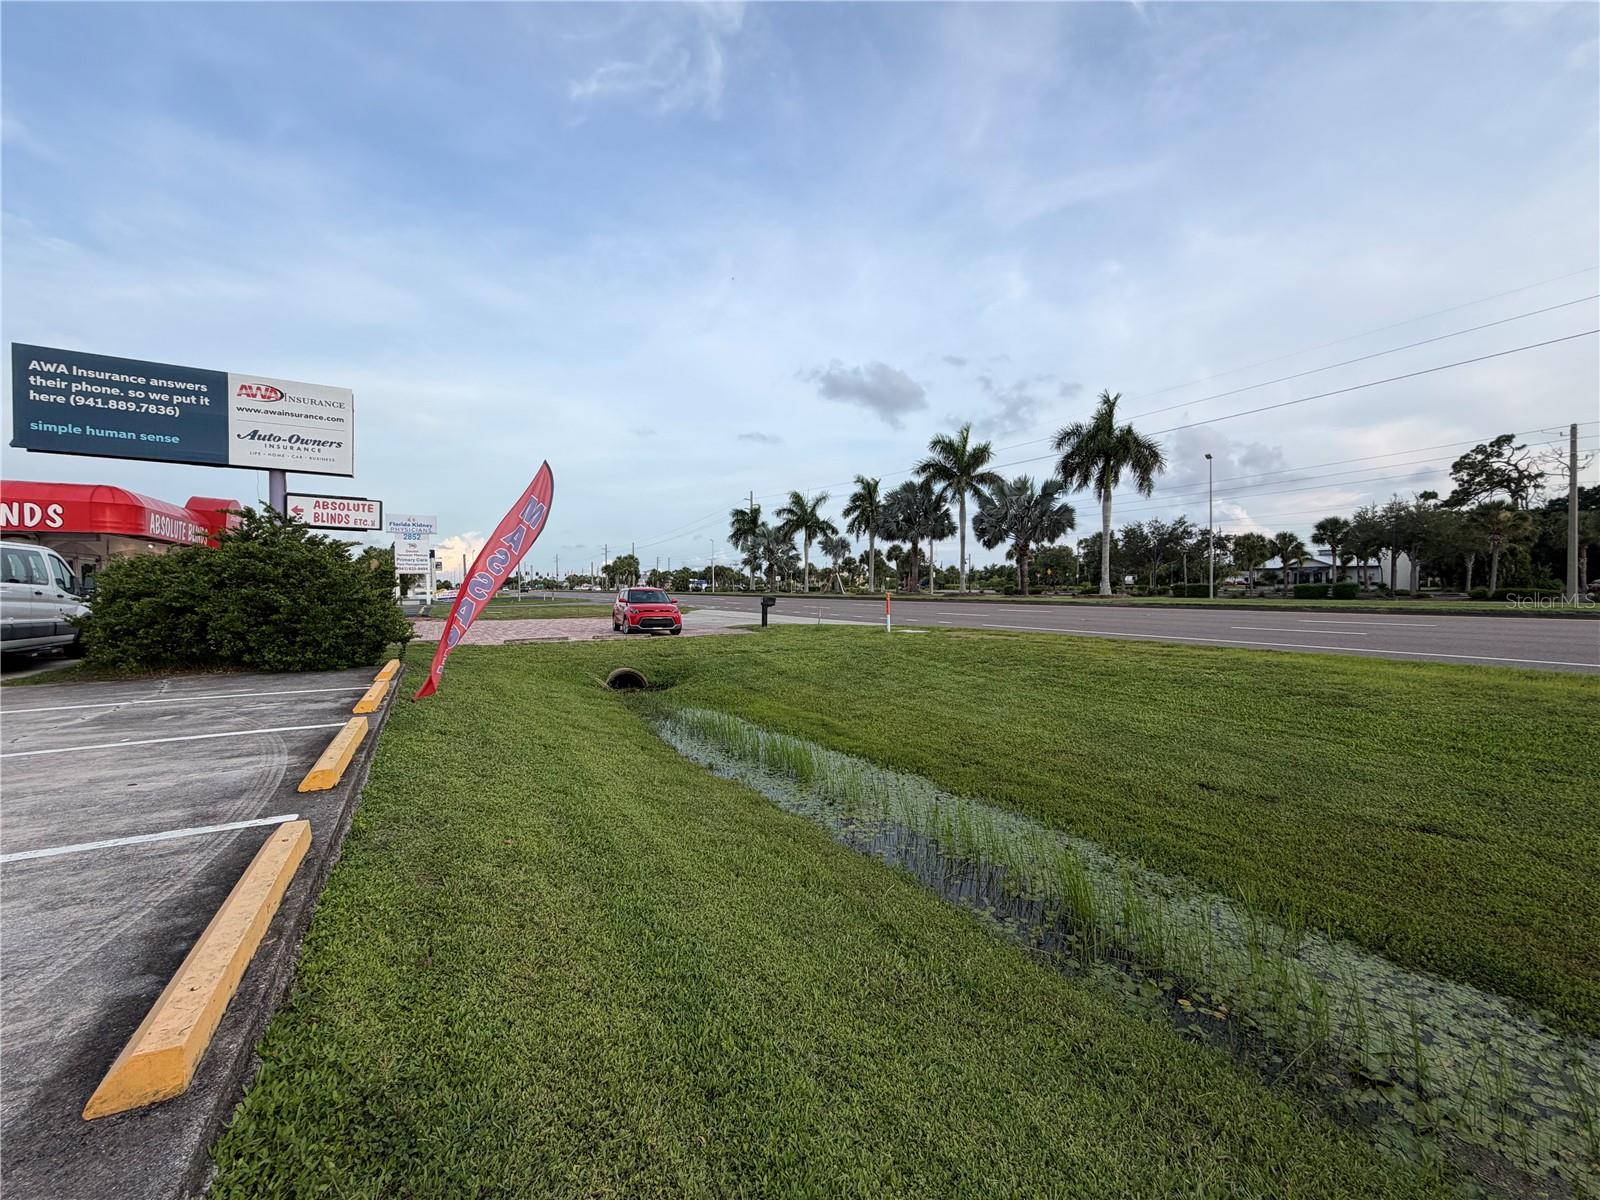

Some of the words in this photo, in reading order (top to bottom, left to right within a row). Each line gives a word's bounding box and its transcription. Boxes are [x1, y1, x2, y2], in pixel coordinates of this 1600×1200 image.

[28, 360, 69, 375] AWA
[72, 365, 147, 385] Insurance
[150, 378, 208, 392] answers
[28, 375, 68, 389] their
[71, 381, 124, 396] phone.
[128, 389, 146, 399] so
[148, 392, 170, 402] we
[173, 394, 197, 405] put
[199, 395, 210, 406] it
[236, 384, 280, 401] AWA
[29, 390, 66, 404] here
[69, 394, 180, 418] (941.889.7836)
[284, 393, 346, 409] INSURANCE
[236, 406, 345, 423] www.awainsurance.com
[30, 420, 82, 435] simple
[86, 425, 137, 440] human
[139, 432, 180, 444] sense
[236, 429, 344, 448] Auto-Owners
[264, 443, 322, 454] INSURANCE
[313, 500, 374, 513] ABSOLUTE
[149, 512, 186, 541] ABSOLUTE
[313, 512, 350, 525] BLINDS
